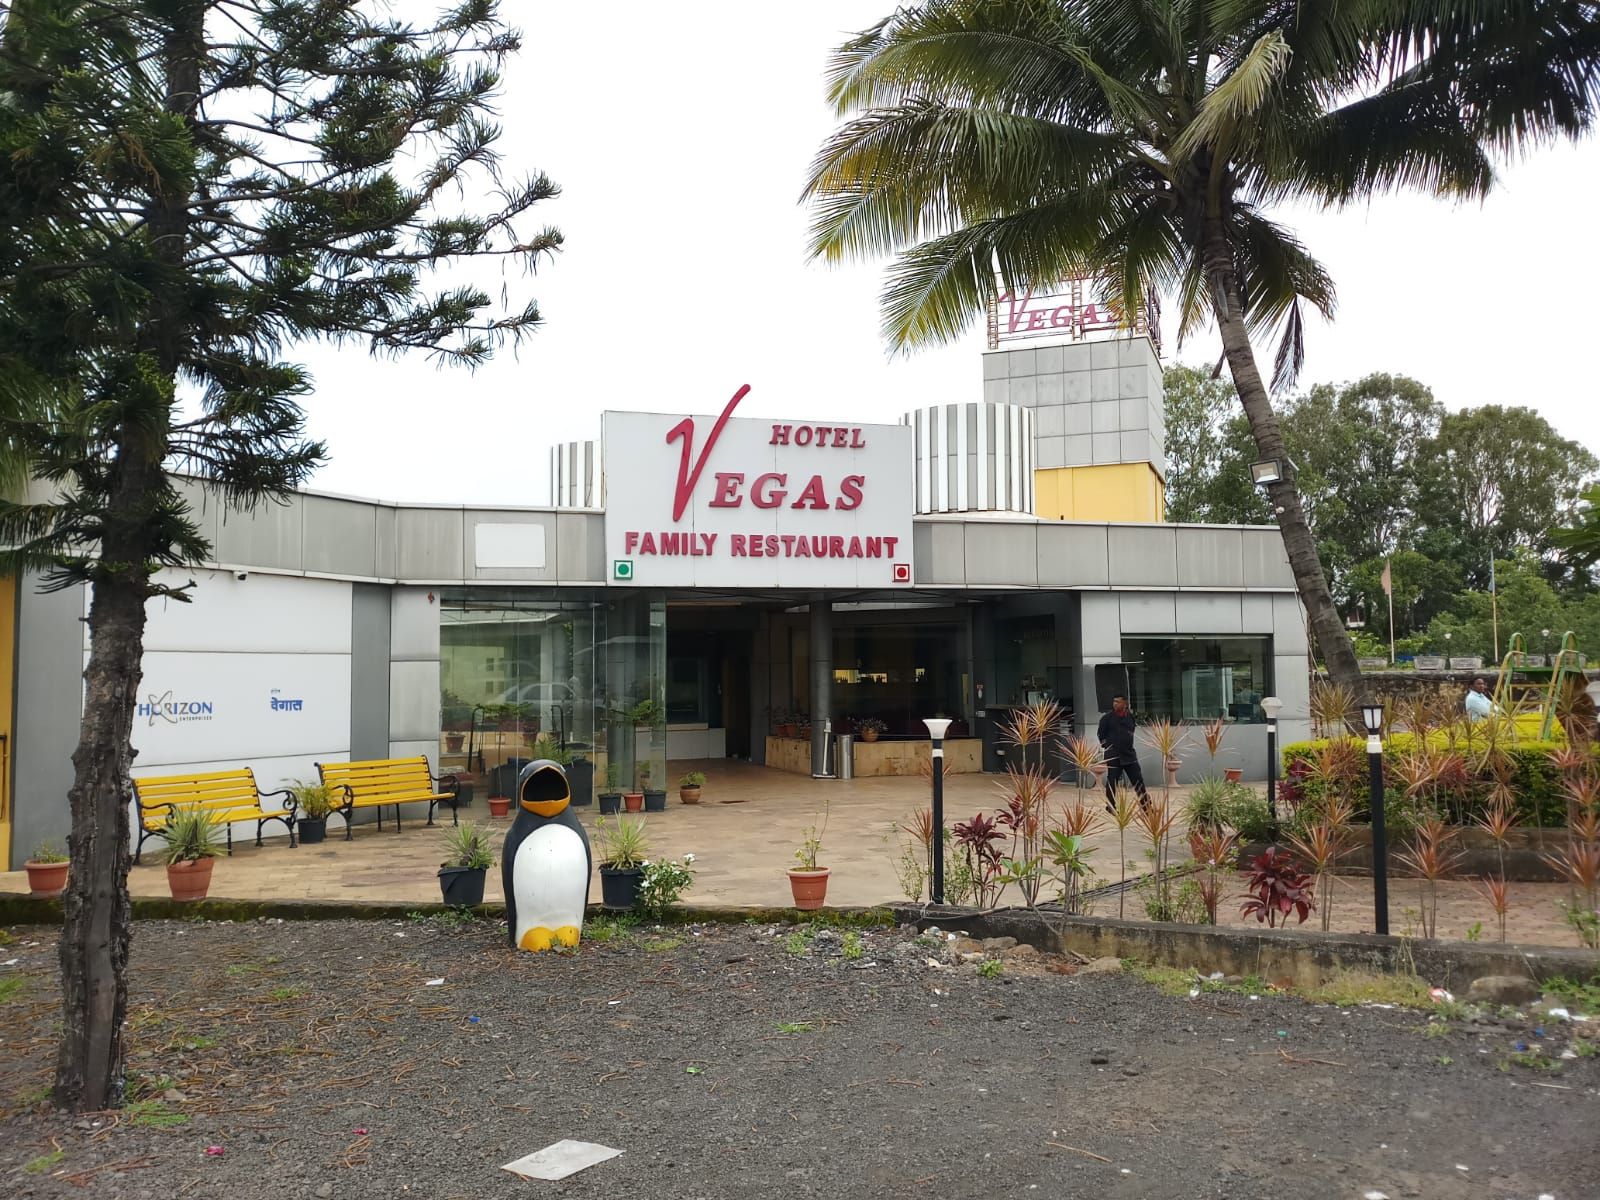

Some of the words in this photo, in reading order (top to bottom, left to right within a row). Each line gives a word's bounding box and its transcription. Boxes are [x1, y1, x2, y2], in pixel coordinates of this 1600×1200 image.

[769, 425, 866, 448] HOTEL
[666, 384, 866, 522] VEGAS
[625, 532, 718, 556] FAMILY
[731, 534, 899, 558] RESTAURANT
[138, 701, 213, 716] HORIZON
